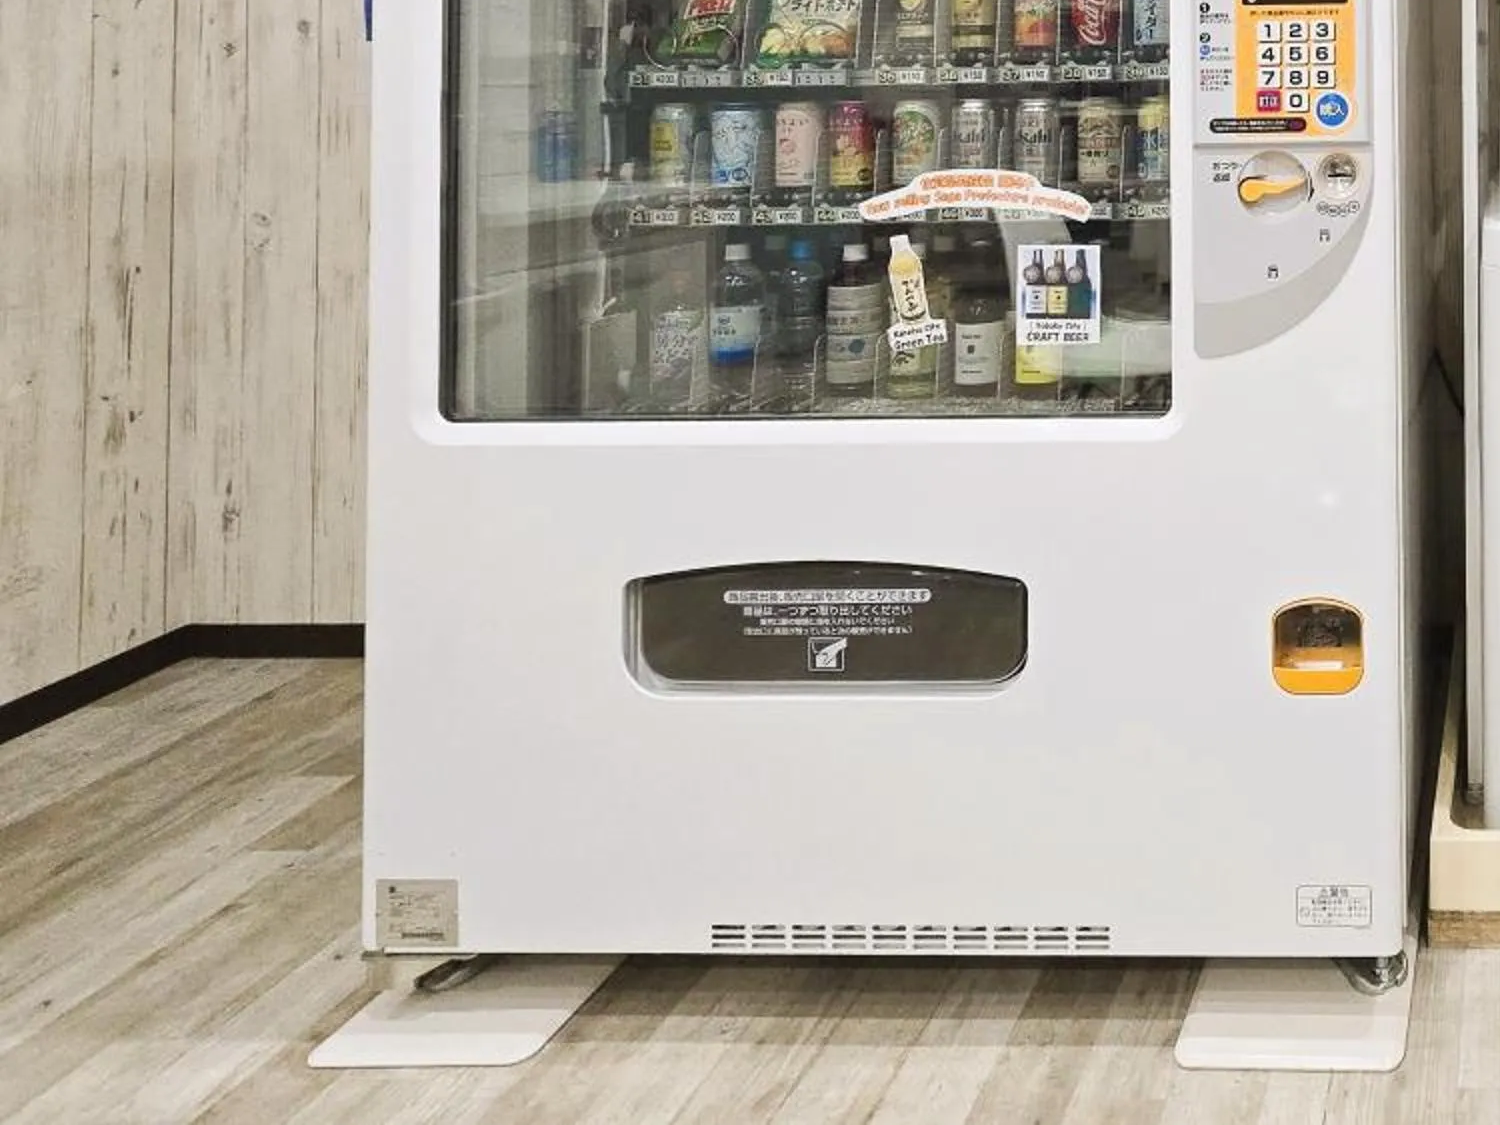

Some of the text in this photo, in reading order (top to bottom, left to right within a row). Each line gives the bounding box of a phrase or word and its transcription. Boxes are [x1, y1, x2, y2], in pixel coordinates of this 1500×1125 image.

[1264, 23, 1329, 38] 1 2 3
[1261, 46, 1329, 62] 4 5 6
[1262, 71, 1329, 85] 7 8 9
[1289, 94, 1303, 108] 0
[893, 336, 925, 352] Green
[1026, 332, 1060, 343] CRAFT
